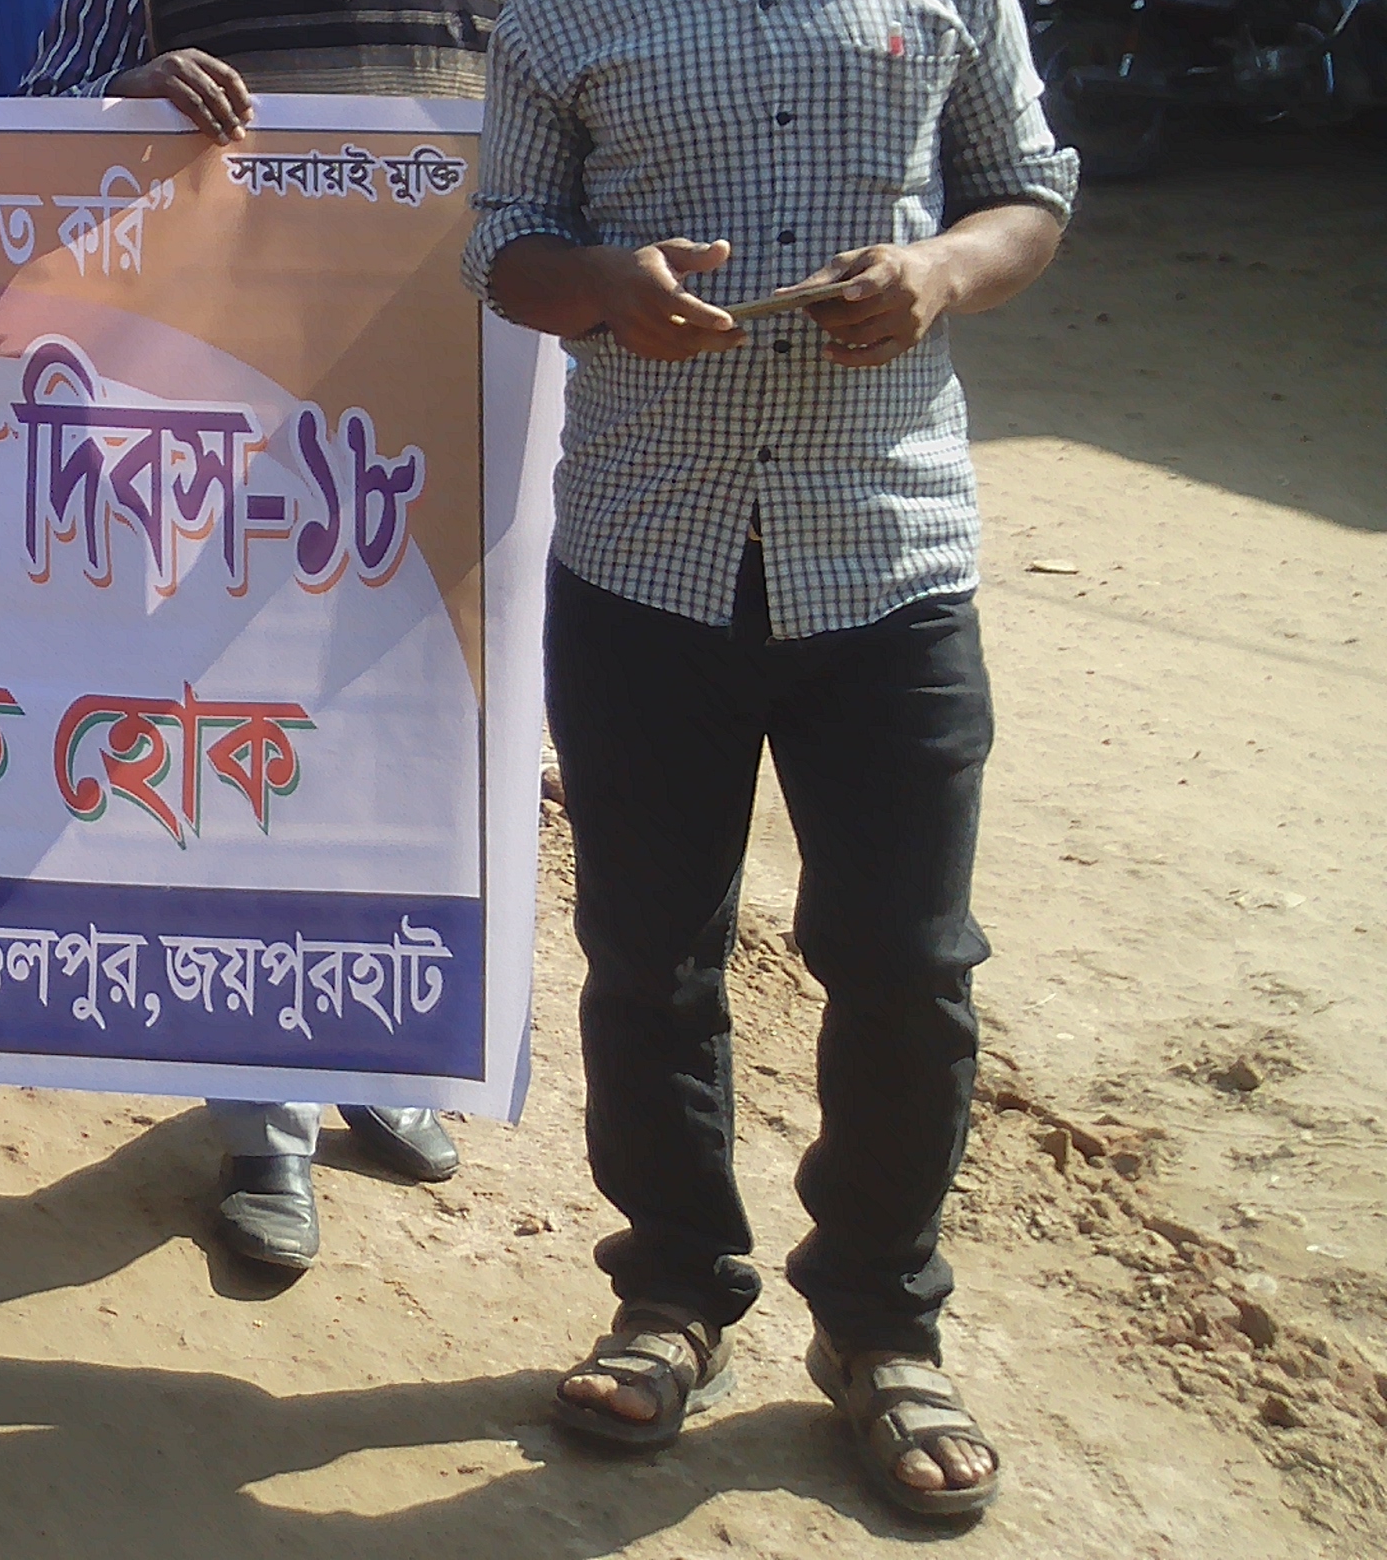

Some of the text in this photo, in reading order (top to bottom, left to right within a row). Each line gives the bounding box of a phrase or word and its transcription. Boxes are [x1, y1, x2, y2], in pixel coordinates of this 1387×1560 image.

[227, 145, 464, 204] সমবায়ই মুক্তি
[55, 685, 313, 848] হোক
